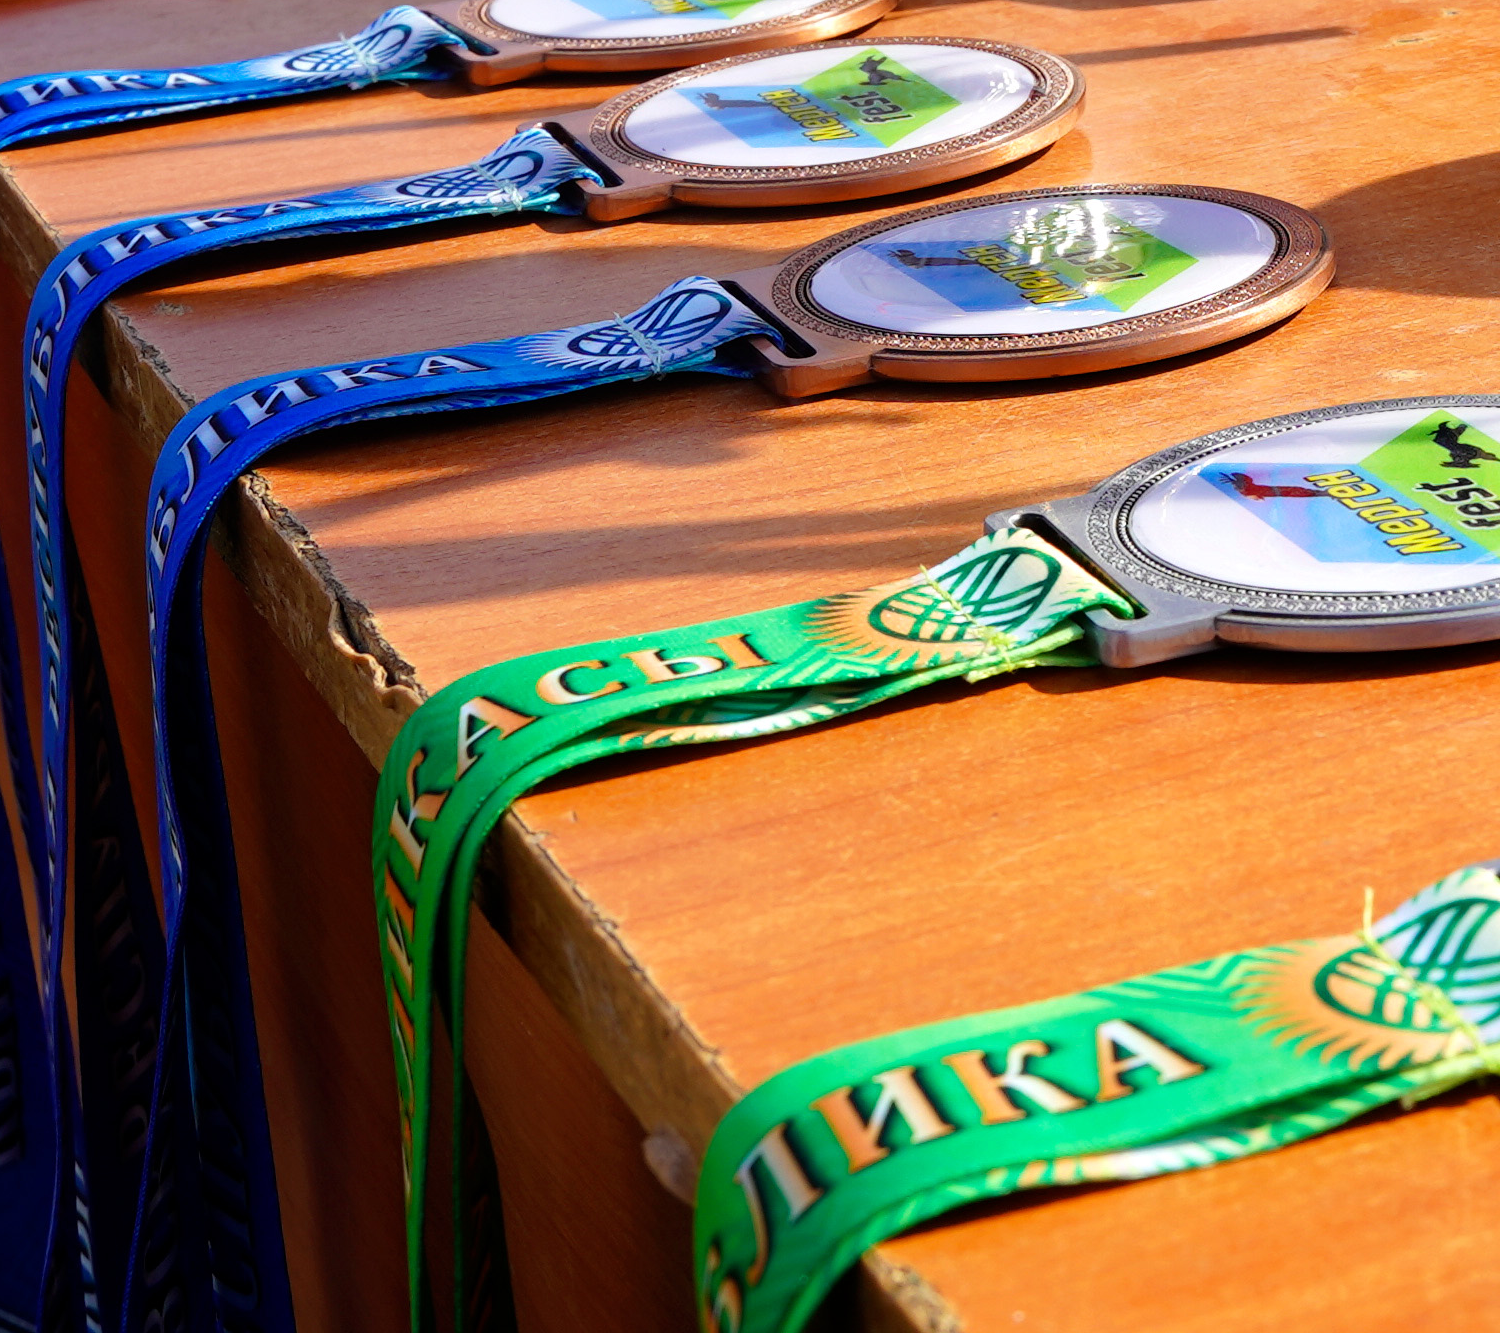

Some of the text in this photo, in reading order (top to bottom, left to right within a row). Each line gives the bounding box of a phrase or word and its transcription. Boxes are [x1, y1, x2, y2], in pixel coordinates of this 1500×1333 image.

[758, 87, 862, 142] Мерген
[837, 90, 914, 126] fest
[958, 243, 1088, 305] Мерген
[1306, 467, 1464, 555] Мерген
